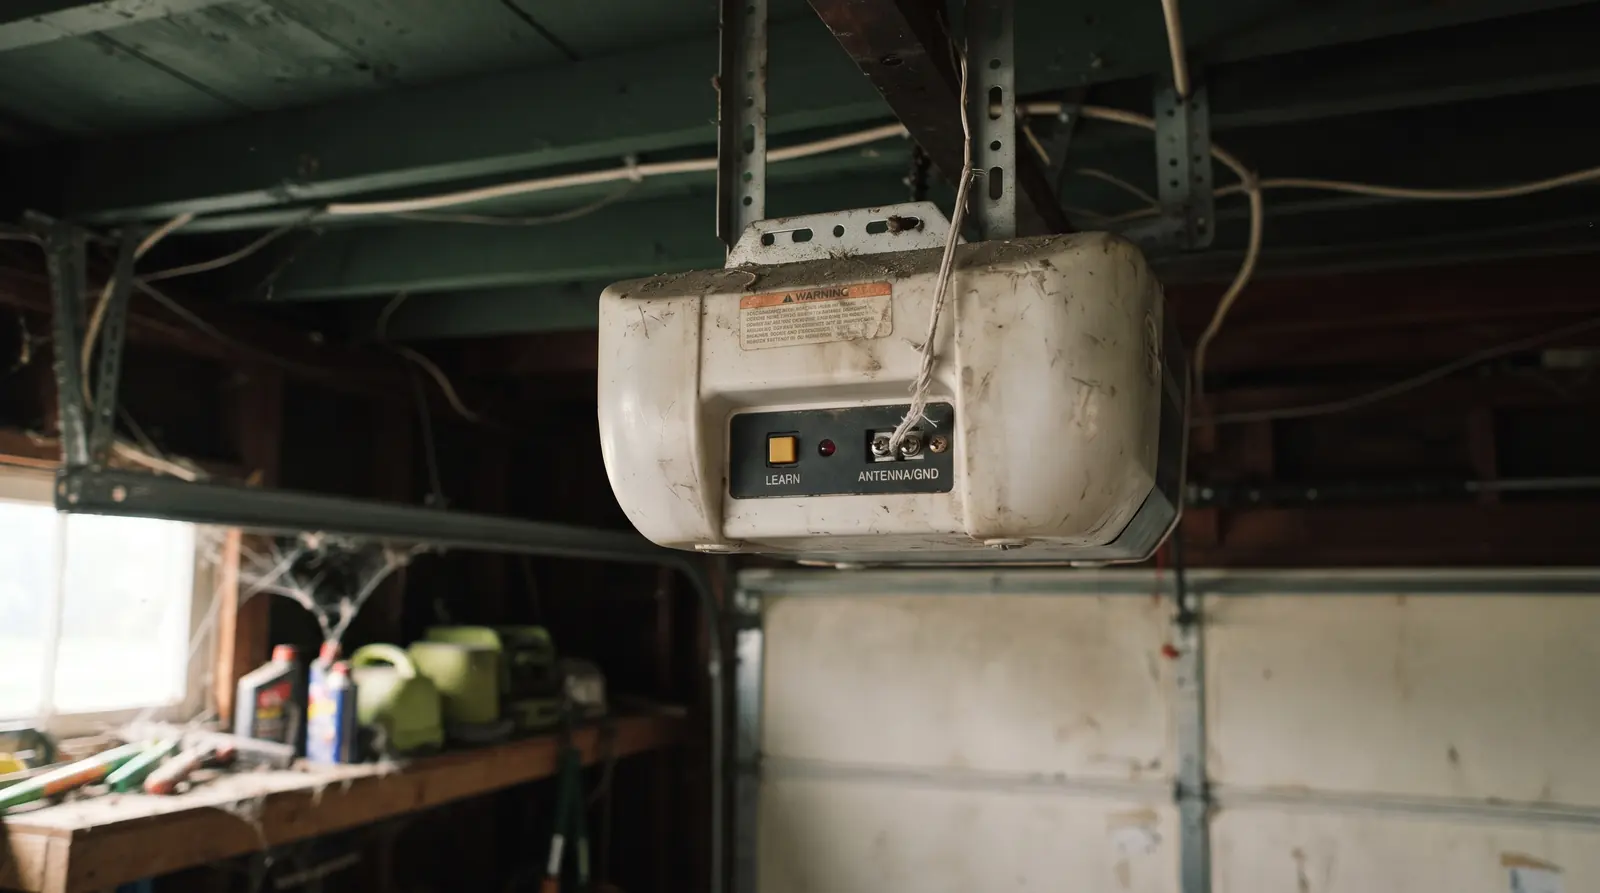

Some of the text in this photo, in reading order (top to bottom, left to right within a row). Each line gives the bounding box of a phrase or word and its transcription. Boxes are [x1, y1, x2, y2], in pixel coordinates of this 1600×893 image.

[795, 287, 849, 301] WARNING
[765, 473, 801, 486] LEARN
[858, 468, 939, 482] ANTENNA/GND
